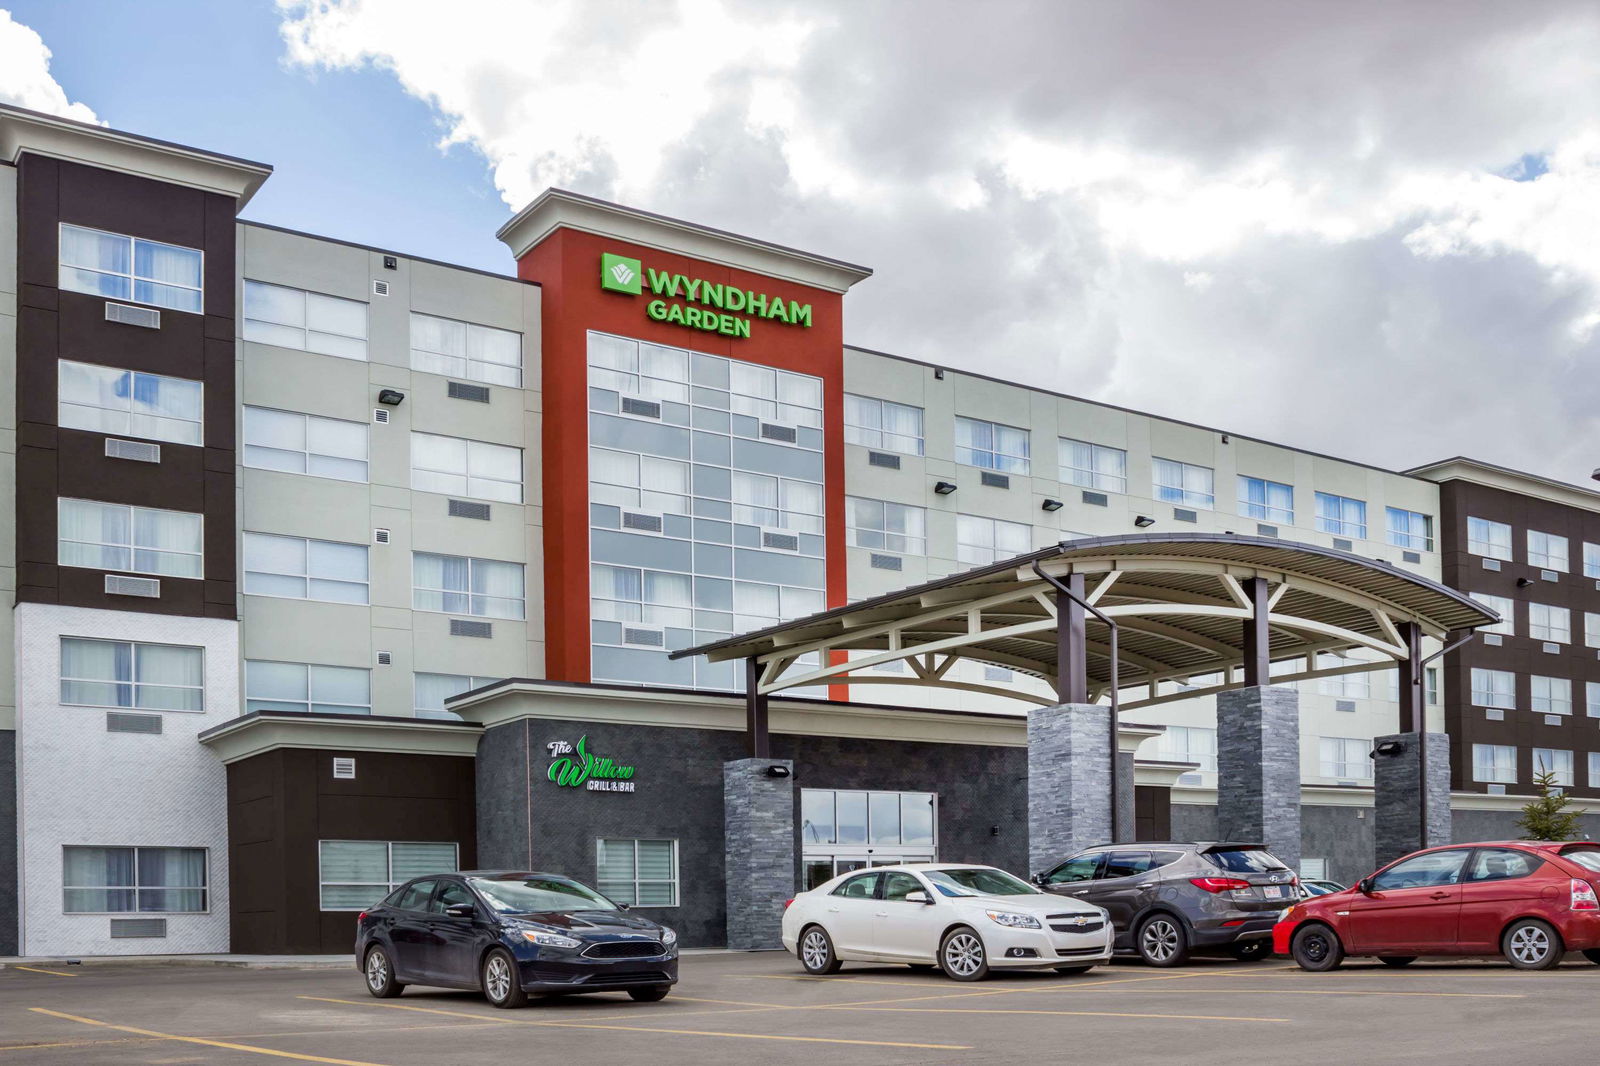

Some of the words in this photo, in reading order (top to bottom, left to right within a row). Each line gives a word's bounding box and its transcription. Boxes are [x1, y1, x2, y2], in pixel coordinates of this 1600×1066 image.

[648, 268, 812, 327] WYNDHAM
[647, 300, 750, 338] GARDEN
[547, 741, 572, 757] The
[547, 751, 635, 787] Willow
[587, 780, 610, 791] GRILL
[611, 782, 618, 791] &
[618, 782, 635, 792] BAR
